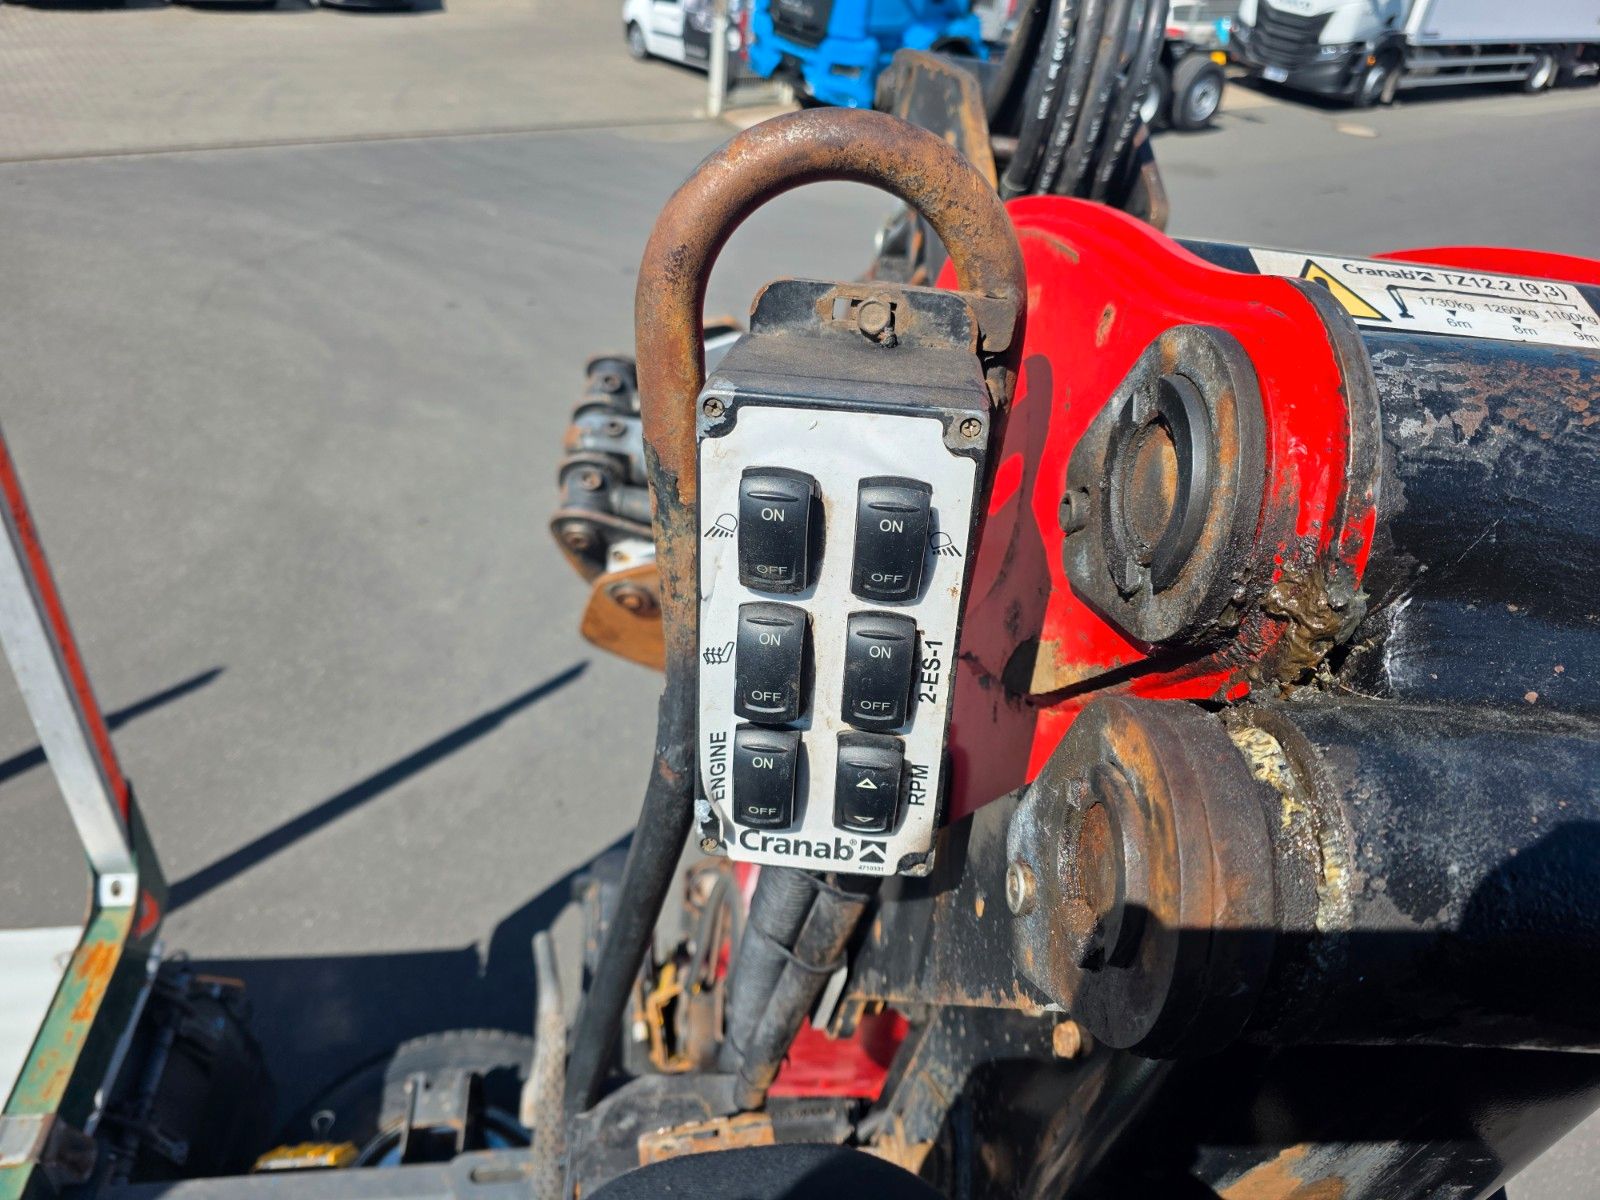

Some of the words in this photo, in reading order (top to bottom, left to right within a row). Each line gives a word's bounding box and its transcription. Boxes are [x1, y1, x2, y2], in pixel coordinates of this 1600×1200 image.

[1438, 273, 1515, 292] TZ12.2
[1519, 282, 1568, 301] (9,3)
[1419, 296, 1475, 312] 1730kg
[1484, 303, 1540, 319] 1260kg
[1545, 309, 1599, 326] 1100kg
[1446, 317, 1472, 329] 6m
[1512, 324, 1538, 336] 8m
[1574, 331, 1600, 343] 9m
[761, 507, 785, 522] ON
[879, 519, 903, 534] ON
[756, 564, 788, 576] OFF
[871, 573, 903, 584] OFF
[759, 632, 781, 646] ON
[869, 645, 892, 659] ON
[918, 640, 943, 704] 2-ES-1
[751, 690, 782, 702] OFF
[860, 700, 891, 711] OFF
[709, 731, 727, 802] ENGINE
[752, 756, 774, 770] ON
[908, 763, 929, 807] RPM
[748, 806, 777, 816] OFF
